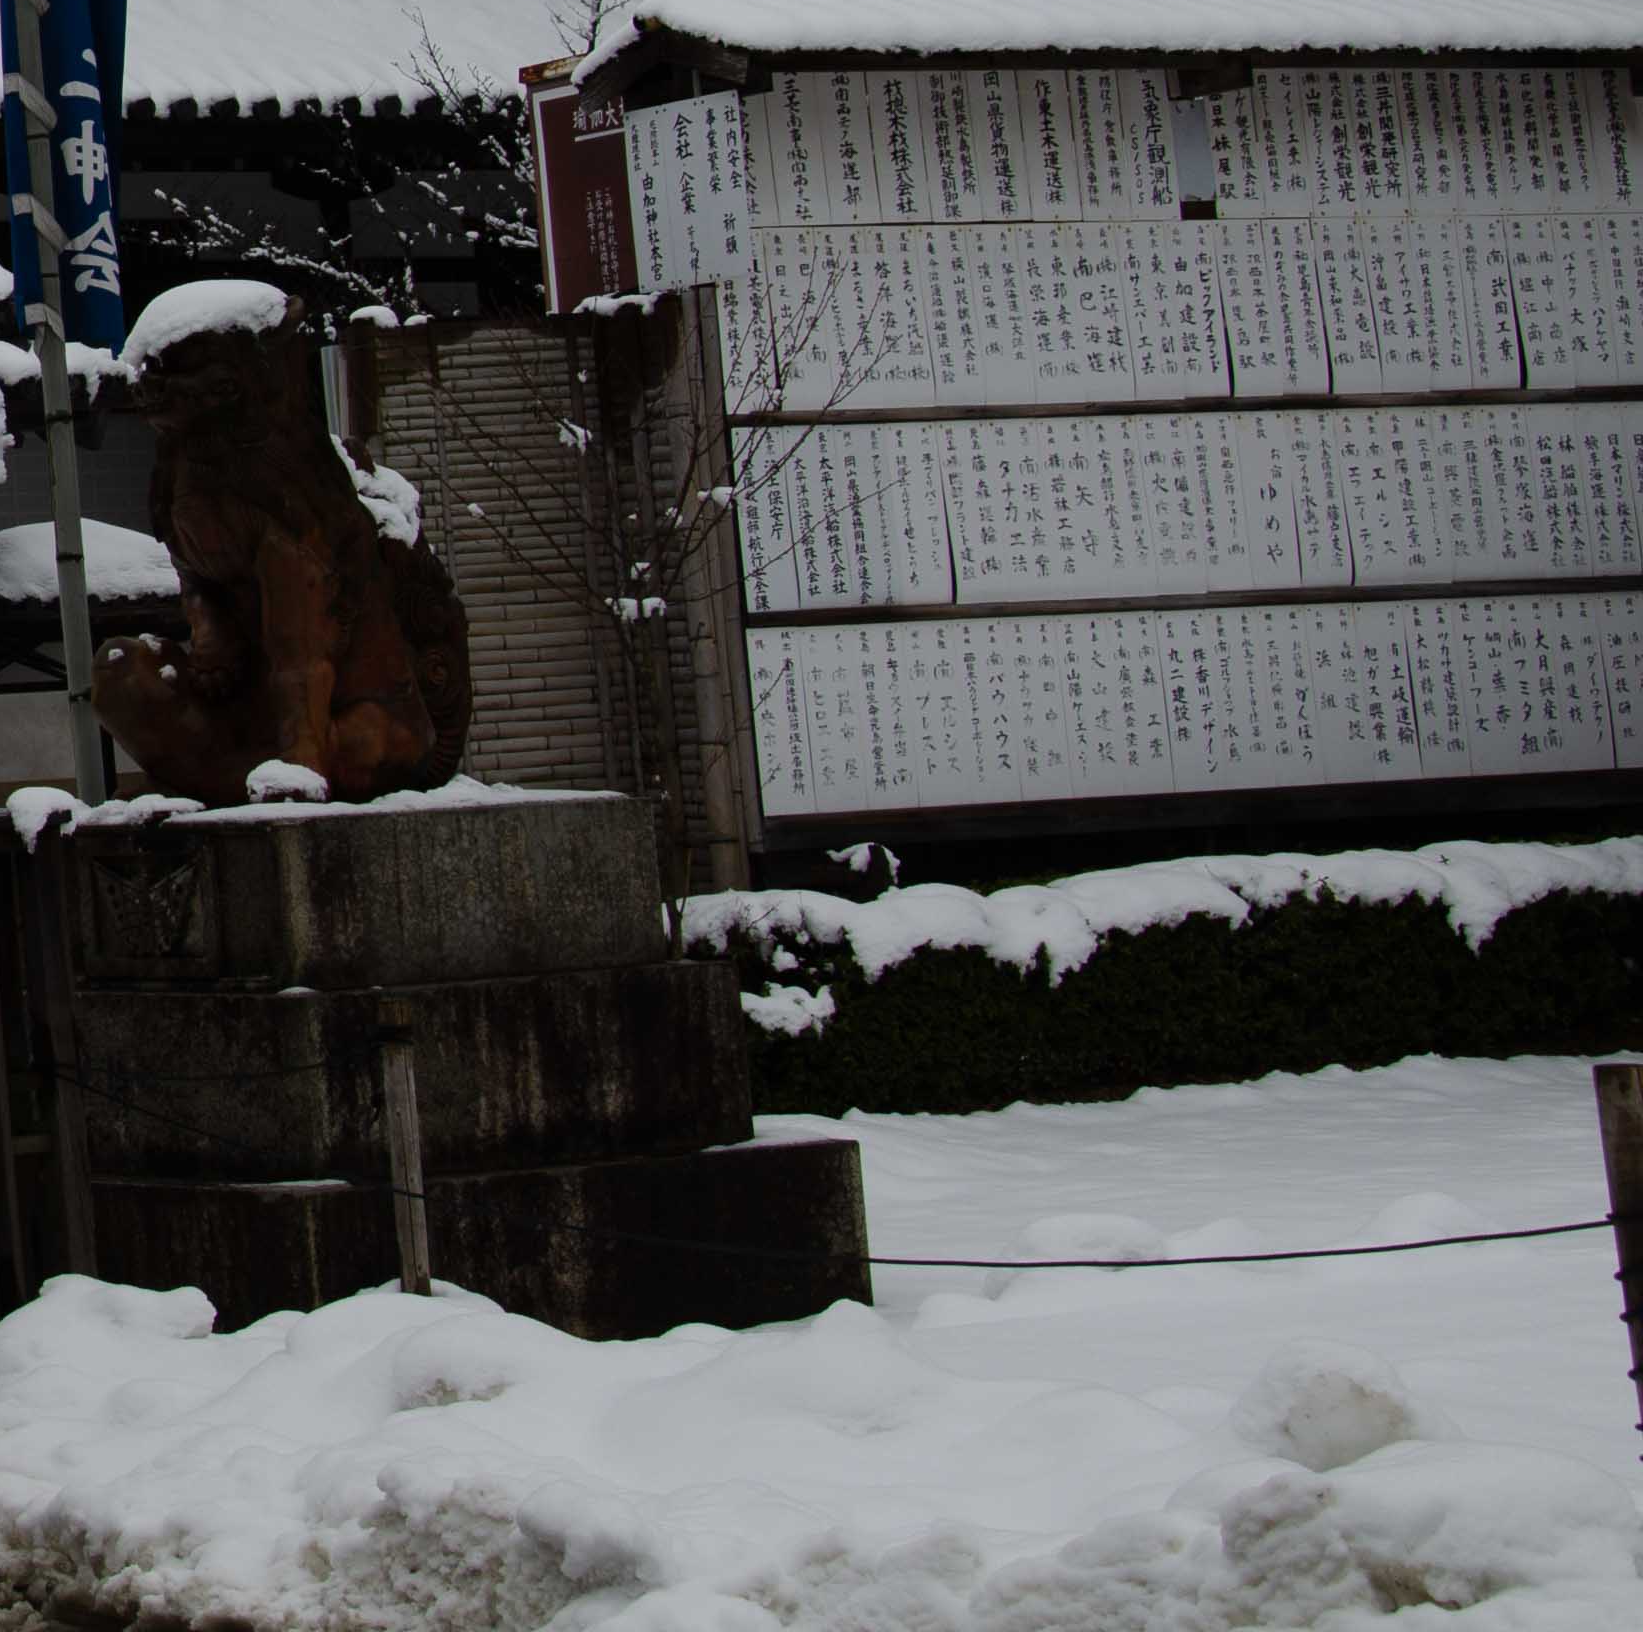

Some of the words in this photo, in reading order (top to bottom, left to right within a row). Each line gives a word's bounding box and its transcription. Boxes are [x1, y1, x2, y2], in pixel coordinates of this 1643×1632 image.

[723, 105, 742, 189] 社内安全
[642, 171, 663, 282] 由加神社本宮
